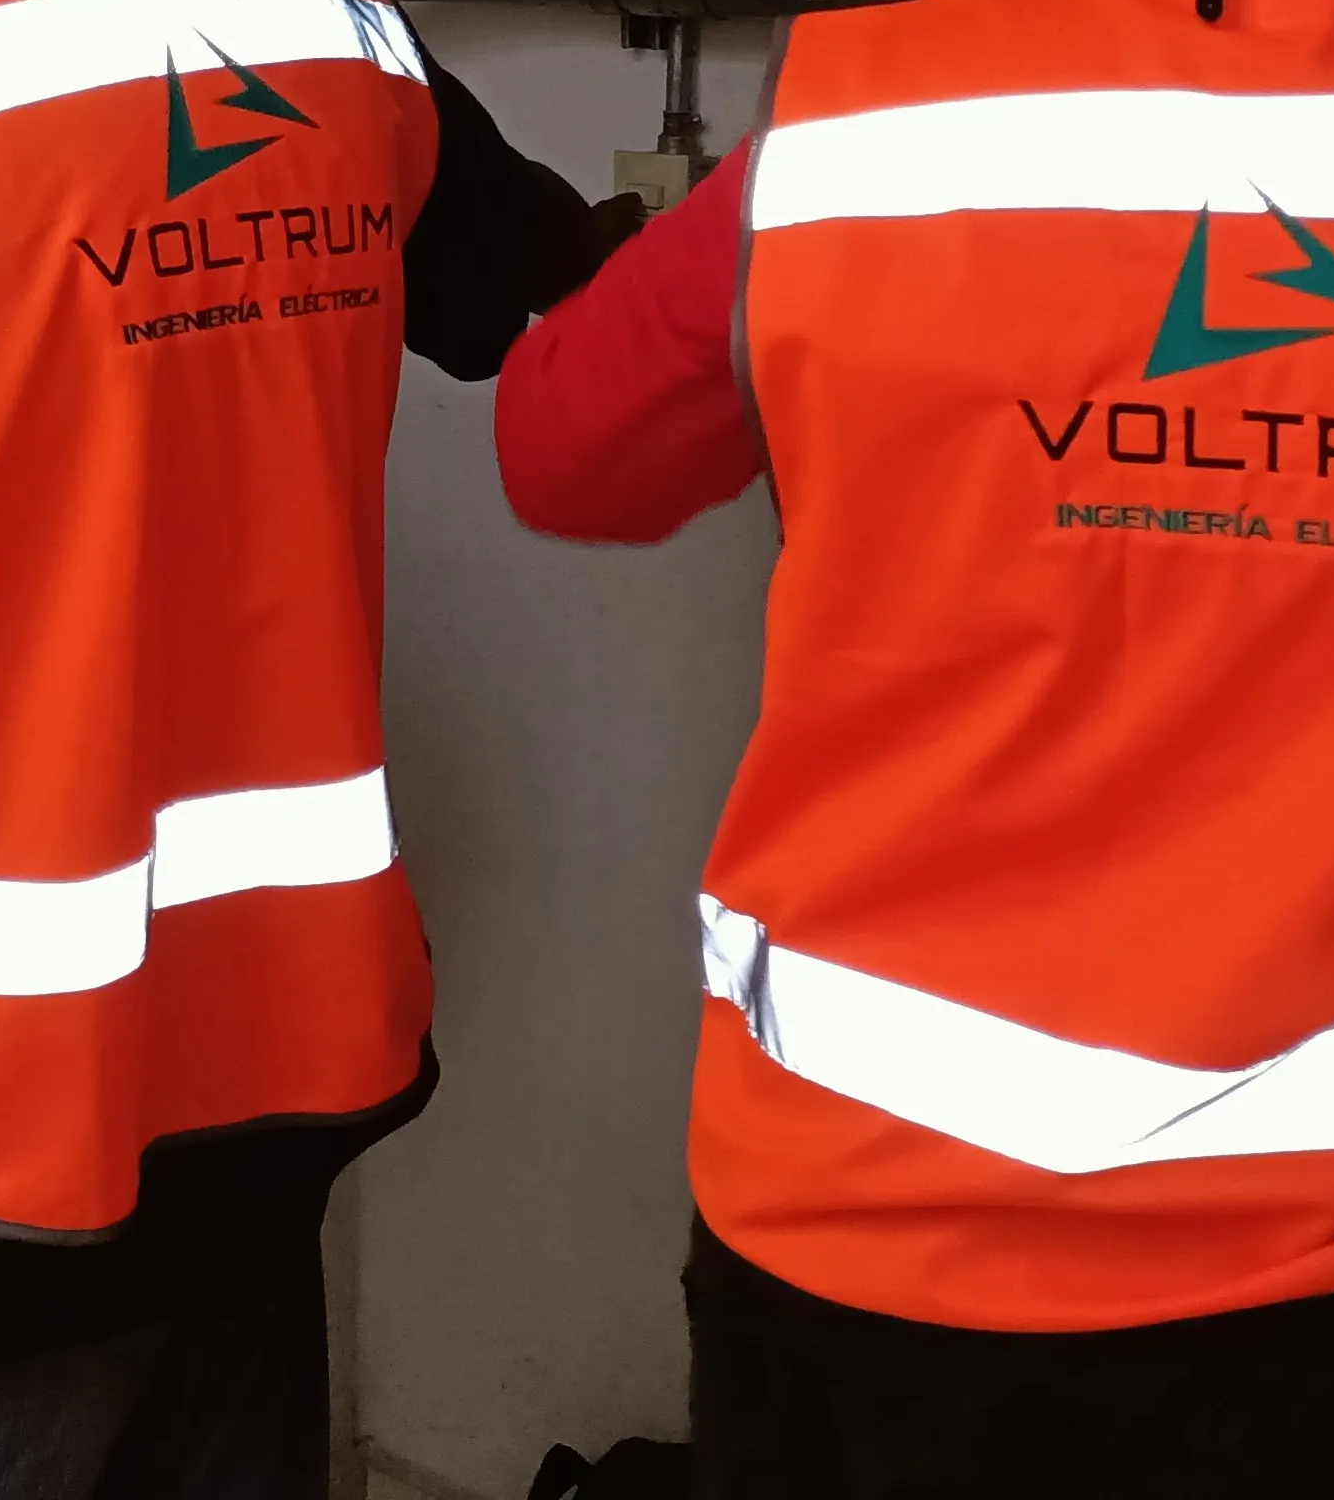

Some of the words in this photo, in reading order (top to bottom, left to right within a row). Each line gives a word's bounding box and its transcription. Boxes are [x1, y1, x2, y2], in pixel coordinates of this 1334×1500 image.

[73, 203, 394, 288] VOLTRUM
[121, 292, 263, 346] INGENIERÍA
[279, 283, 380, 319] ELÉCTRICA
[1055, 502, 1274, 542] INGENIERÍA
